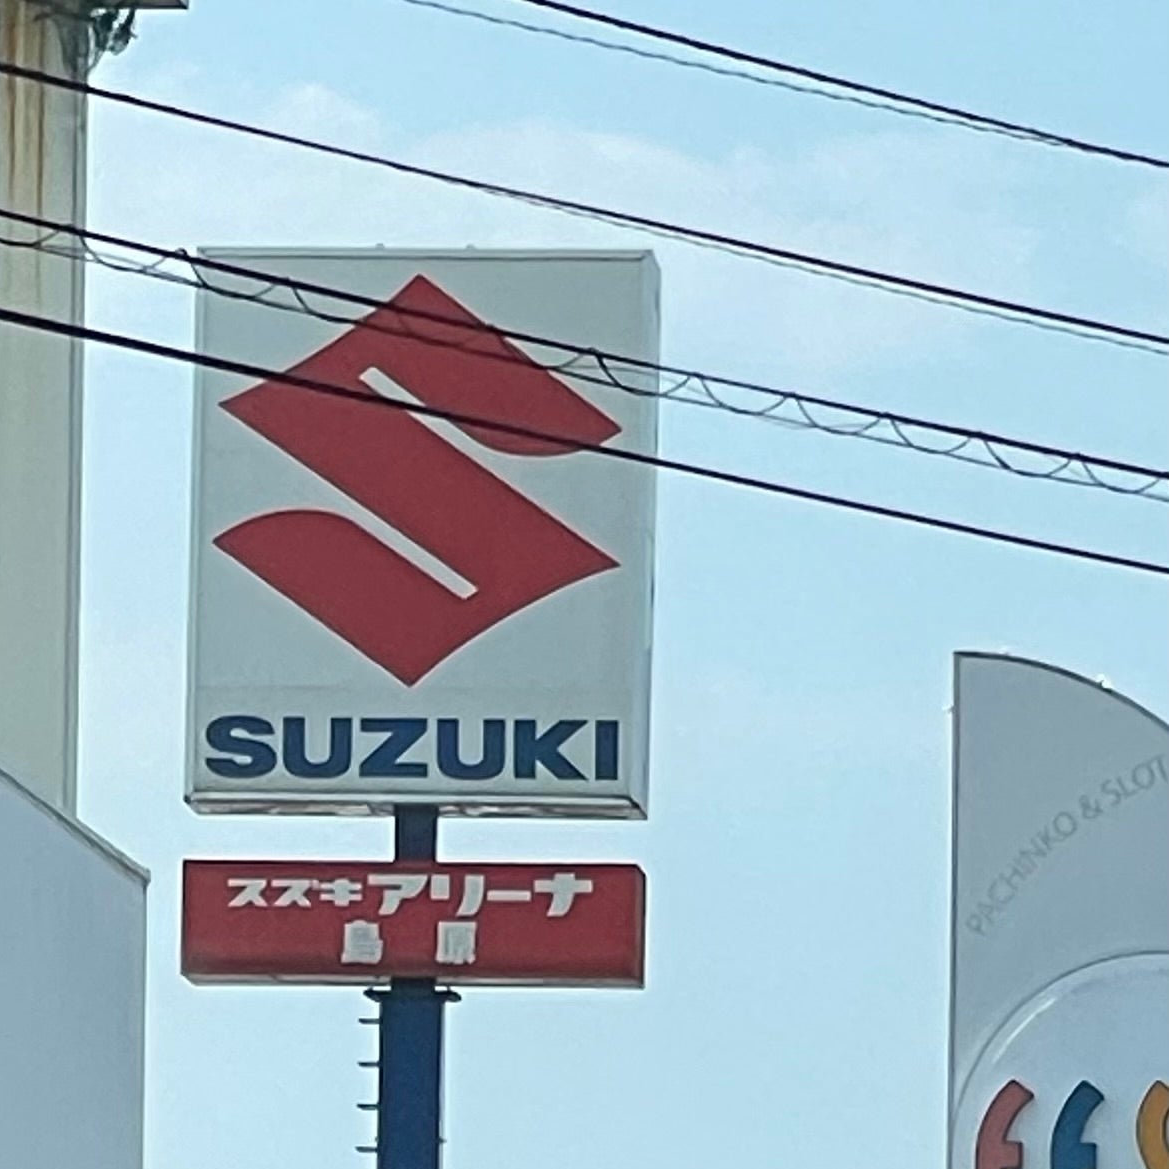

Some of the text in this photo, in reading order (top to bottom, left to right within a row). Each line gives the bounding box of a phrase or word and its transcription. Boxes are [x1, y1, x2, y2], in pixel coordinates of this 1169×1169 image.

[205, 715, 619, 781] SUZUKI
[965, 754, 1169, 937] PACHINKO & SLOT
[227, 872, 594, 917] スズキアリーナ
[341, 920, 478, 965] 島原
